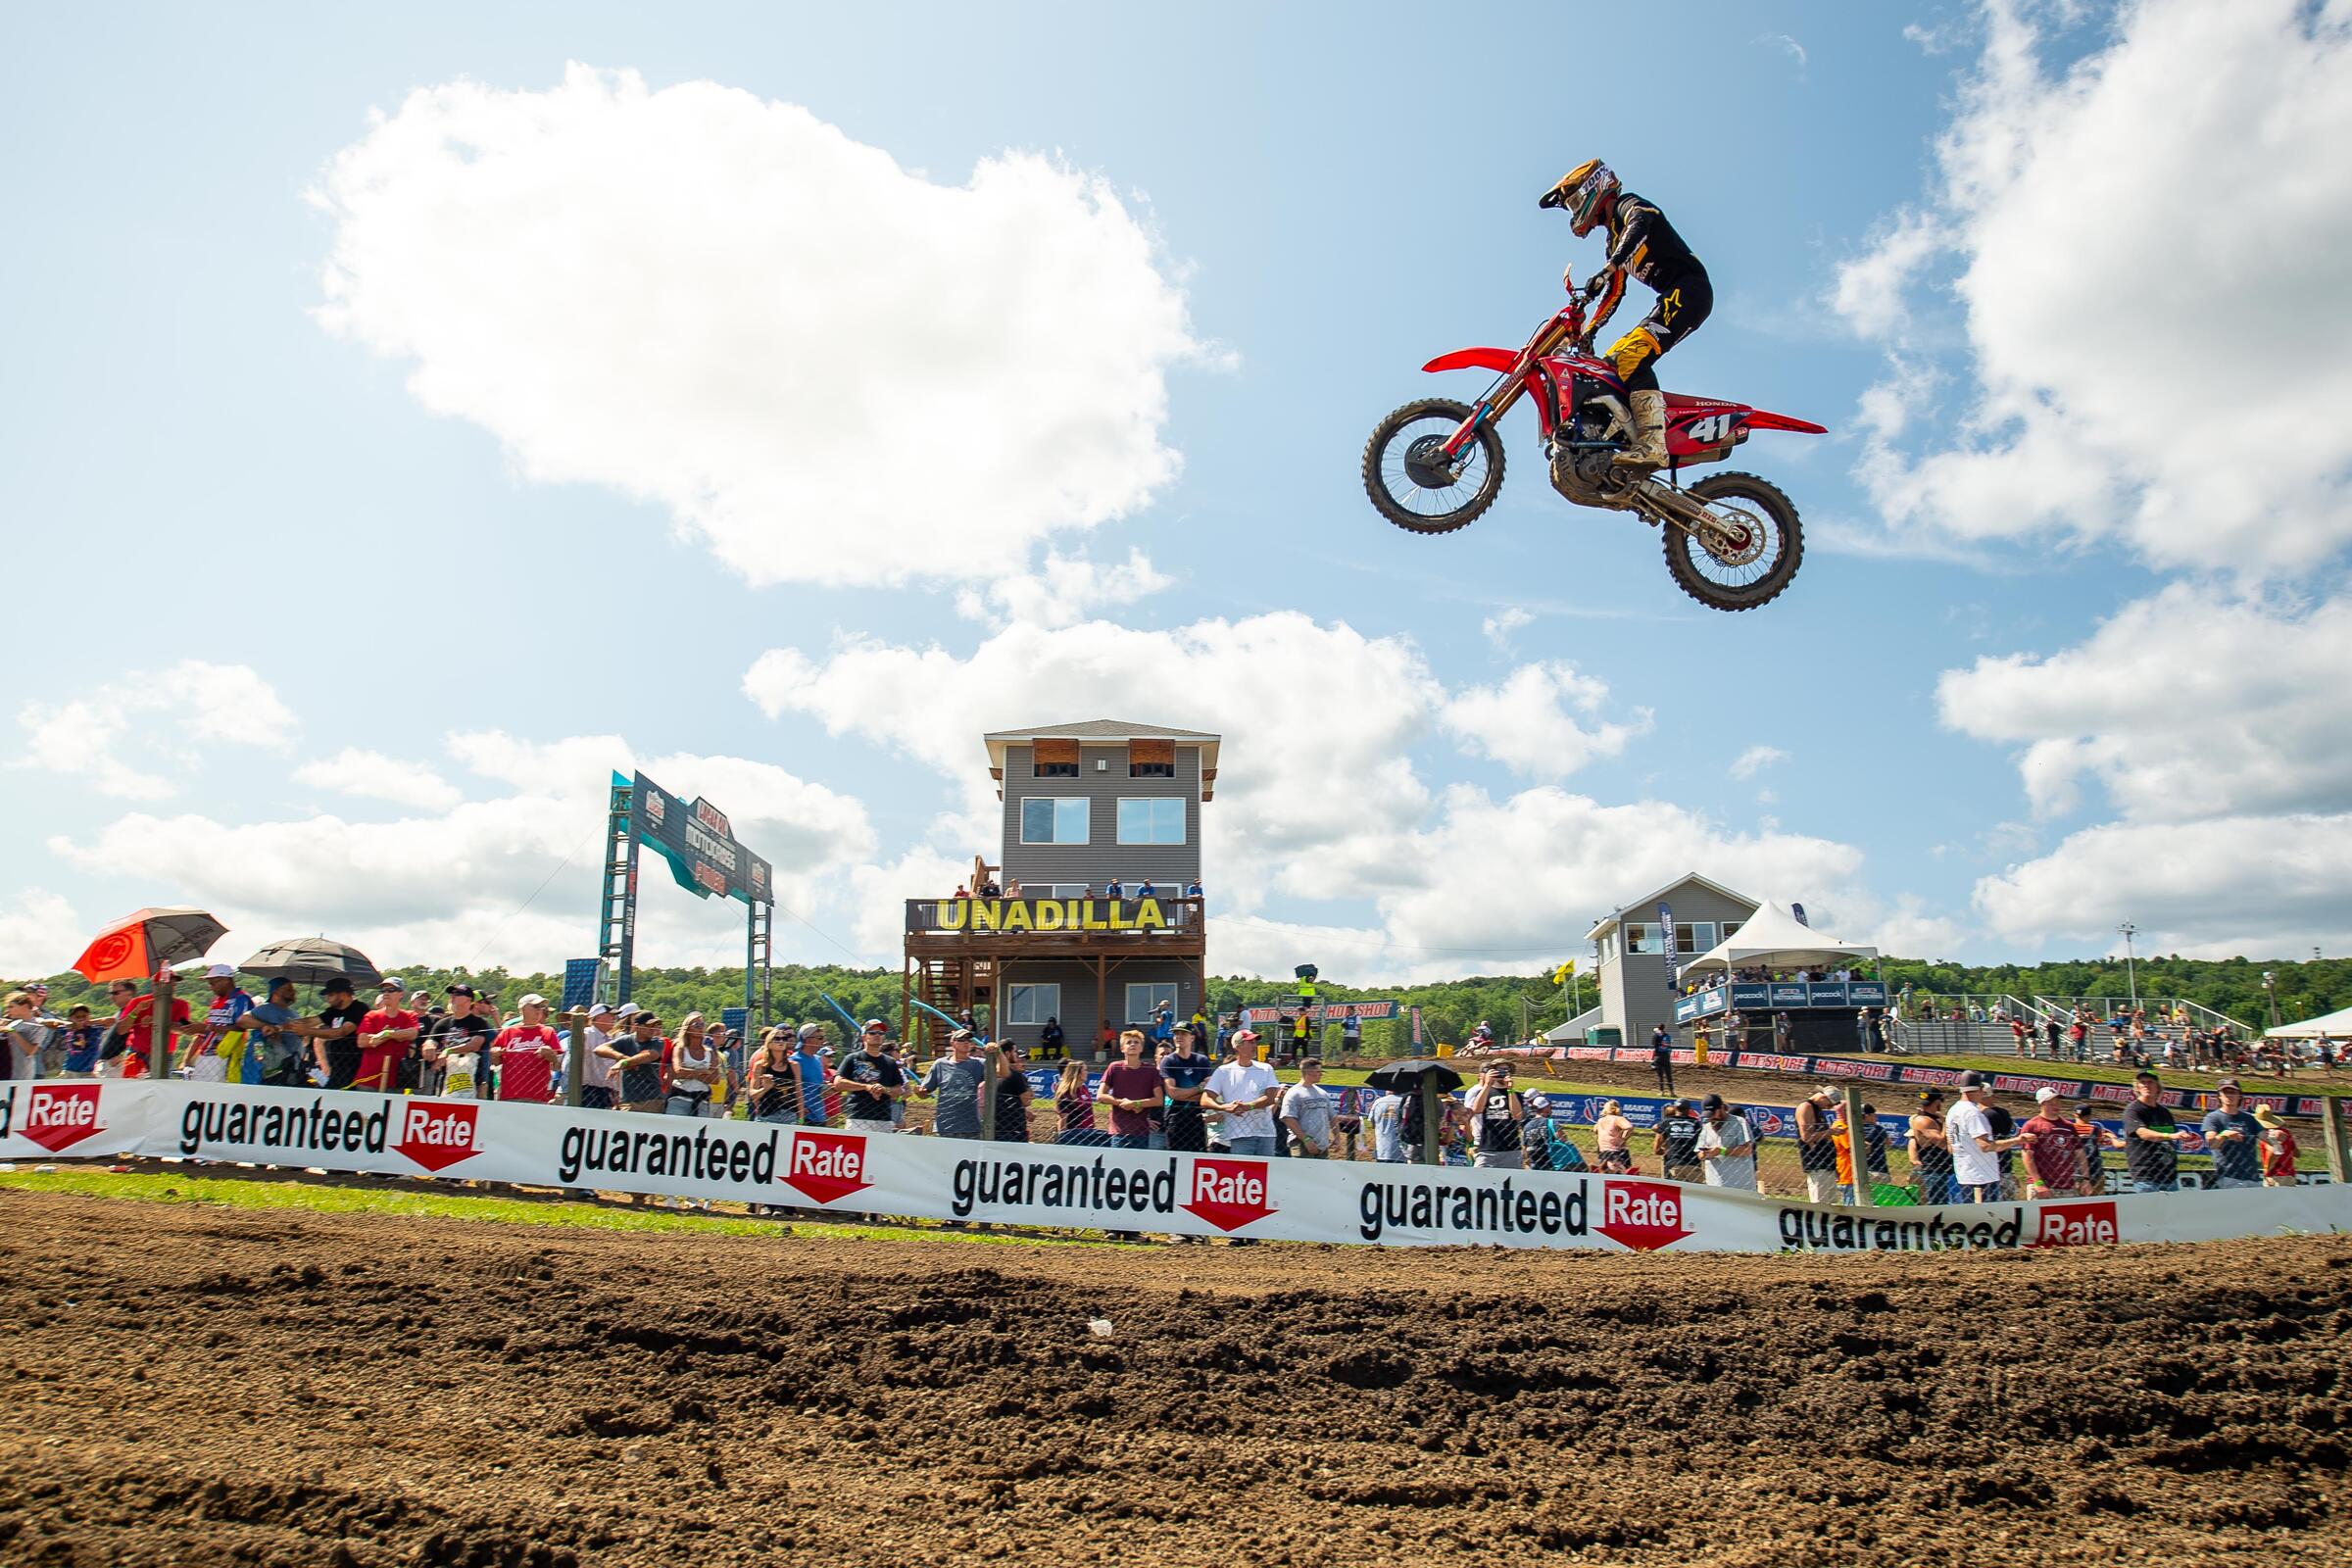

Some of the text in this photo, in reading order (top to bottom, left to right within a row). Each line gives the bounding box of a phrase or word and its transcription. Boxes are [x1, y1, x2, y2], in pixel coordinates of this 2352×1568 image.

[1688, 414, 1732, 443] 41
[937, 898, 1166, 931] UNADILLA
[1326, 1004, 1391, 1018] HOLSHOT
[29, 1093, 95, 1126] Rate
[179, 1096, 471, 1154] guaranteed Rate
[559, 1125, 859, 1185] guaranteed Rate
[952, 1154, 1263, 1217] guaranteed Rate
[1360, 1176, 1678, 1241] guaranteed Rate
[1778, 1206, 2115, 1251] guaranteed Rate
